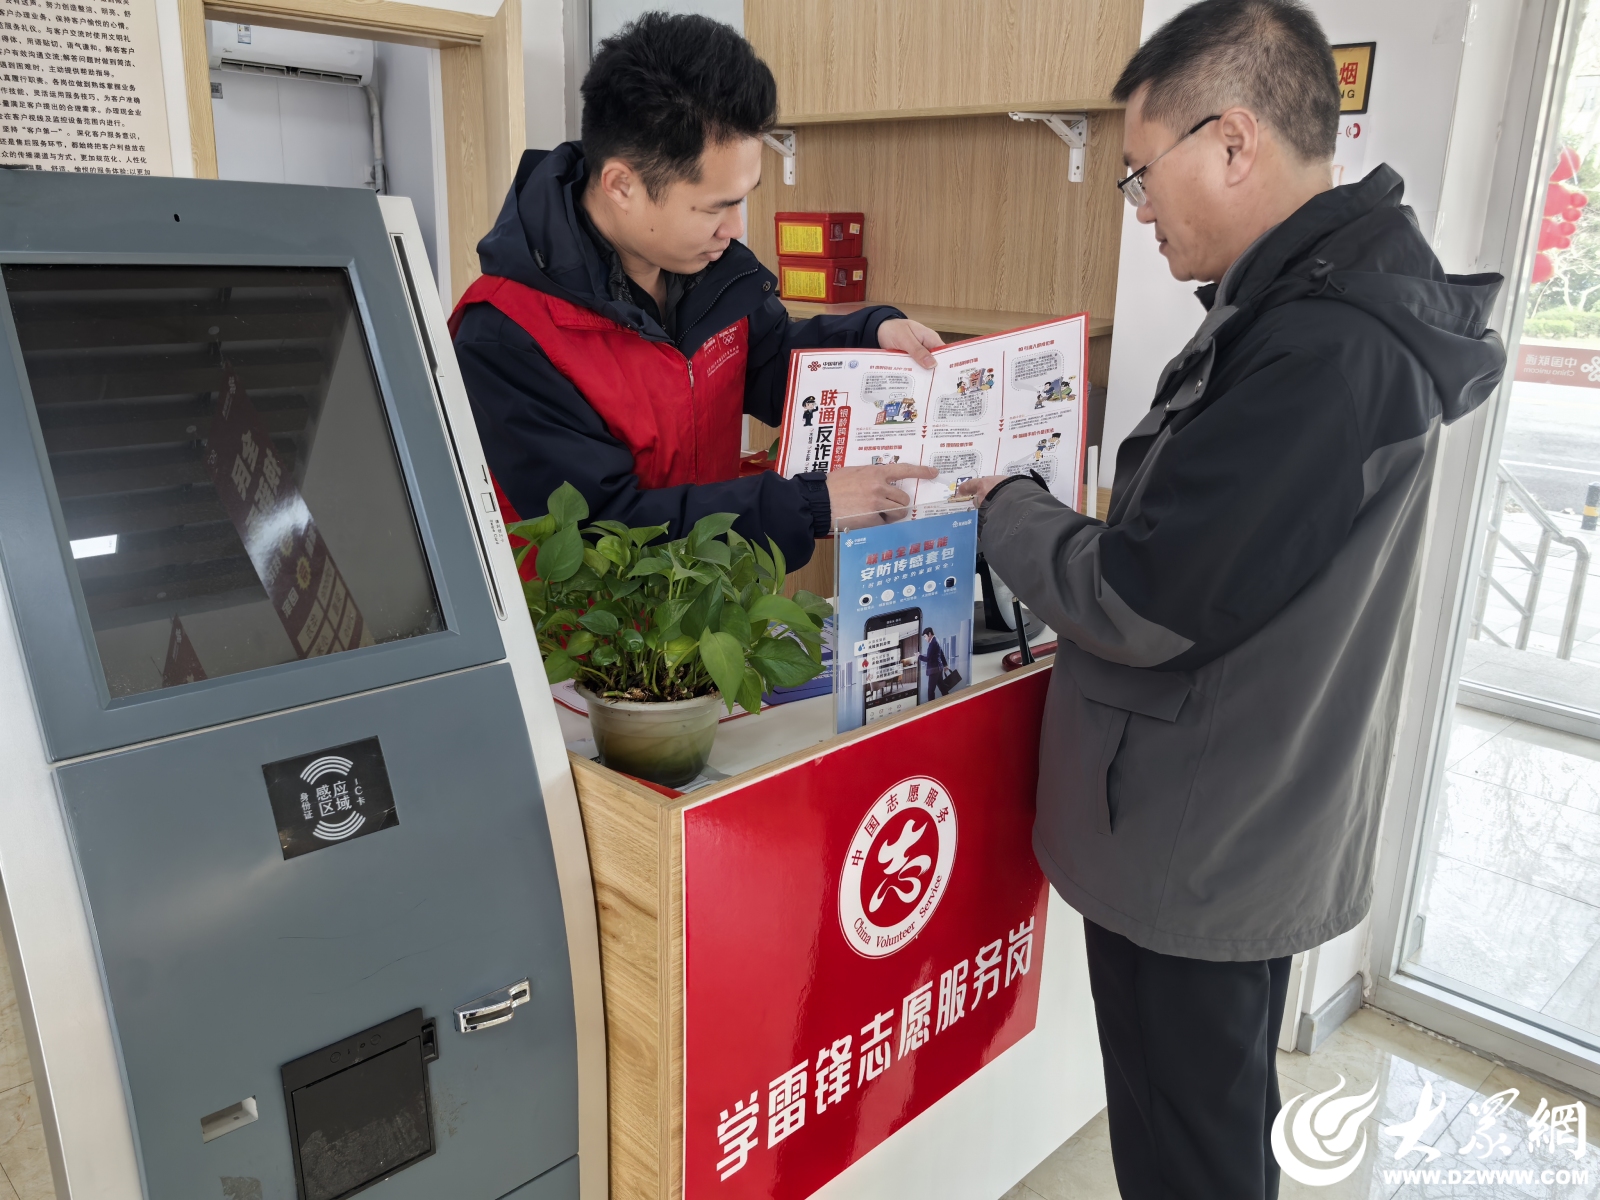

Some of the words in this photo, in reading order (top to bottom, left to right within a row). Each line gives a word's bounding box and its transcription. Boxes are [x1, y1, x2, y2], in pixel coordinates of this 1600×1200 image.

[1339, 62, 1359, 85] 烟
[316, 780, 349, 801] 感应
[300, 792, 314, 820] 身份证
[319, 795, 353, 817] 区域
[851, 783, 949, 866] 中国志愿服务
[853, 917, 872, 945] China
[876, 921, 916, 948] Volunteer
[919, 874, 943, 918] Service
[716, 916, 1036, 1182] 学雷锋志愿服务岗
